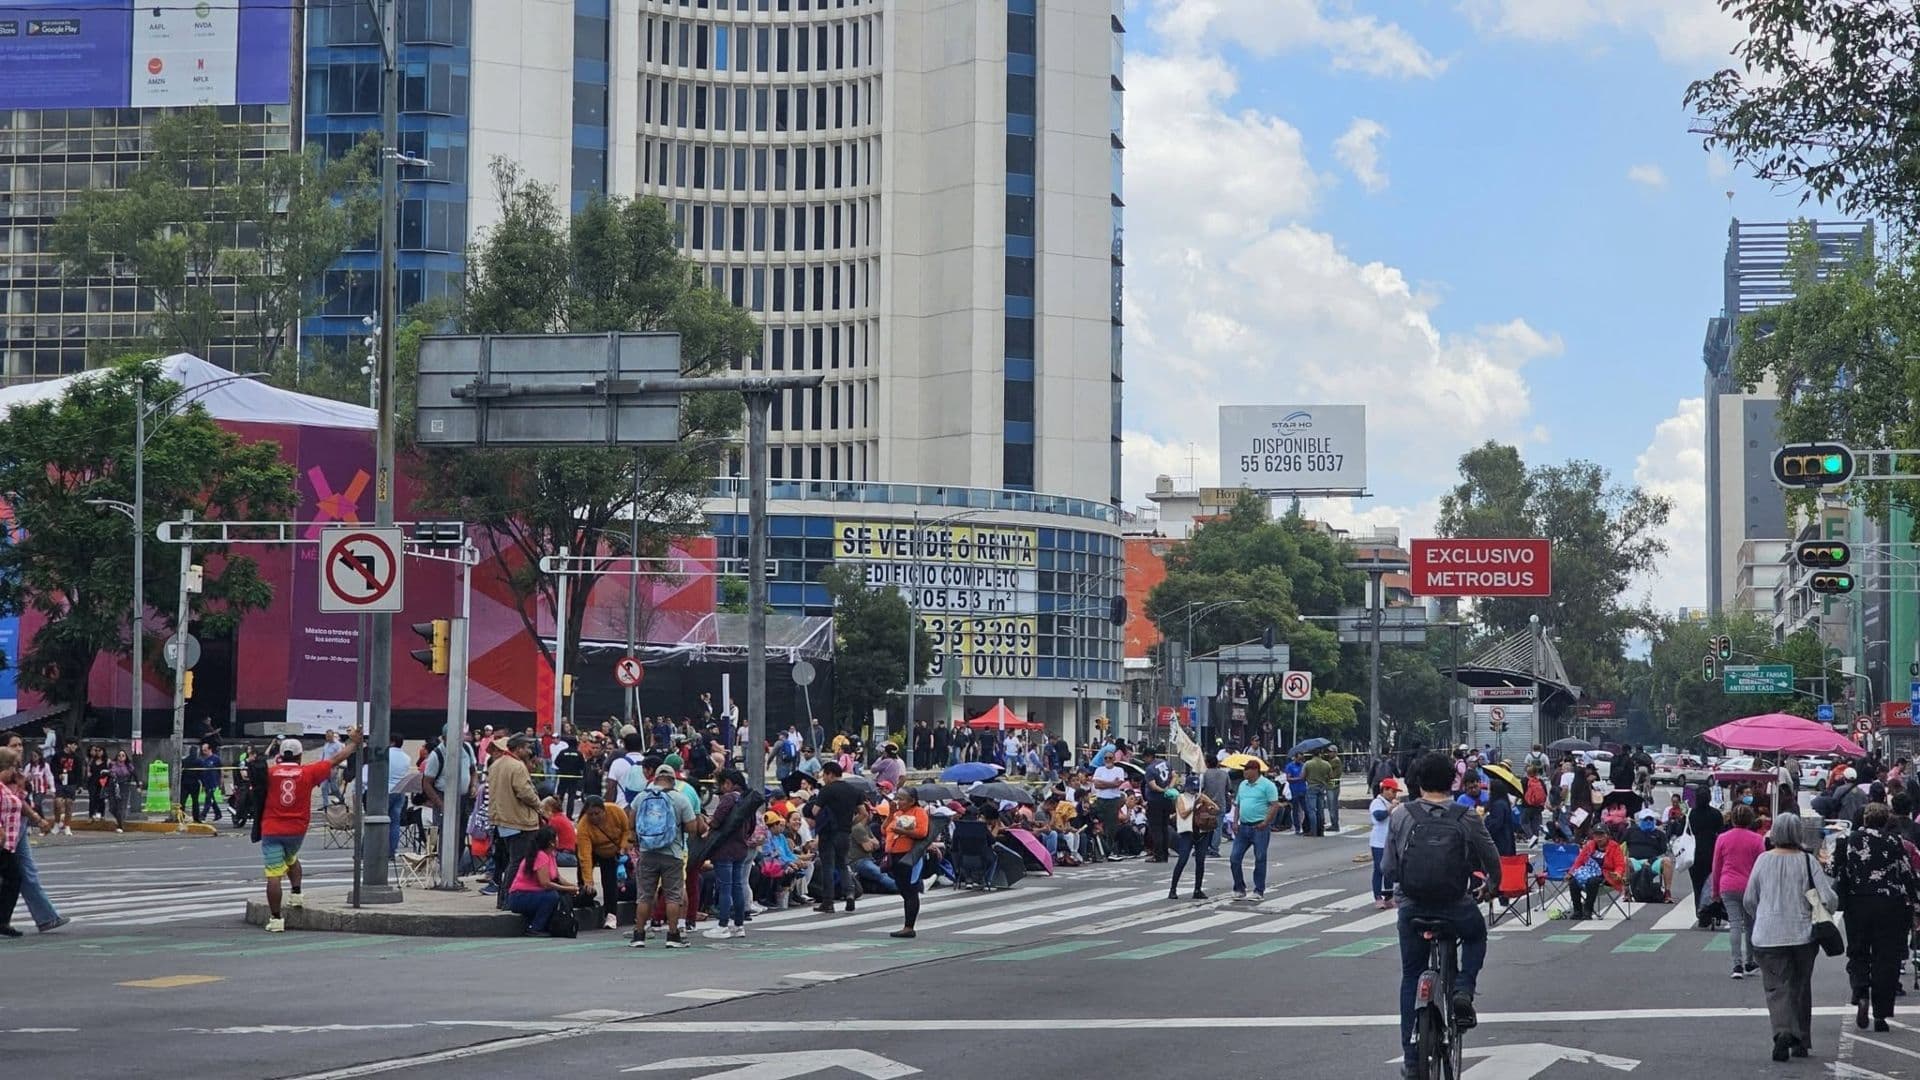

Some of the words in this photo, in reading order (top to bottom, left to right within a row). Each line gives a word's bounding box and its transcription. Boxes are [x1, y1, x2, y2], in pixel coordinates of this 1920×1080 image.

[41, 25, 64, 34] Google
[65, 25, 78, 33] Play
[1252, 437, 1332, 454] DISPONIBLE
[1241, 455, 1259, 472] 55
[1264, 455, 1302, 472] 6296
[1307, 454, 1344, 471] 5037
[842, 526, 872, 555] SE
[878, 528, 953, 558] VENDE
[977, 532, 1032, 562] RENTA
[1426, 548, 1535, 564] EXCLUSIVO
[865, 564, 937, 585] EDIFICIO
[940, 565, 1020, 588] COMPLETO
[1427, 571, 1534, 587] METROBUS
[974, 620, 1031, 648] 3399
[973, 650, 1031, 677] 0000
[1729, 684, 1756, 692] ANTONIO
[1757, 684, 1775, 692] CASO
[282, 779, 295, 805] 8
